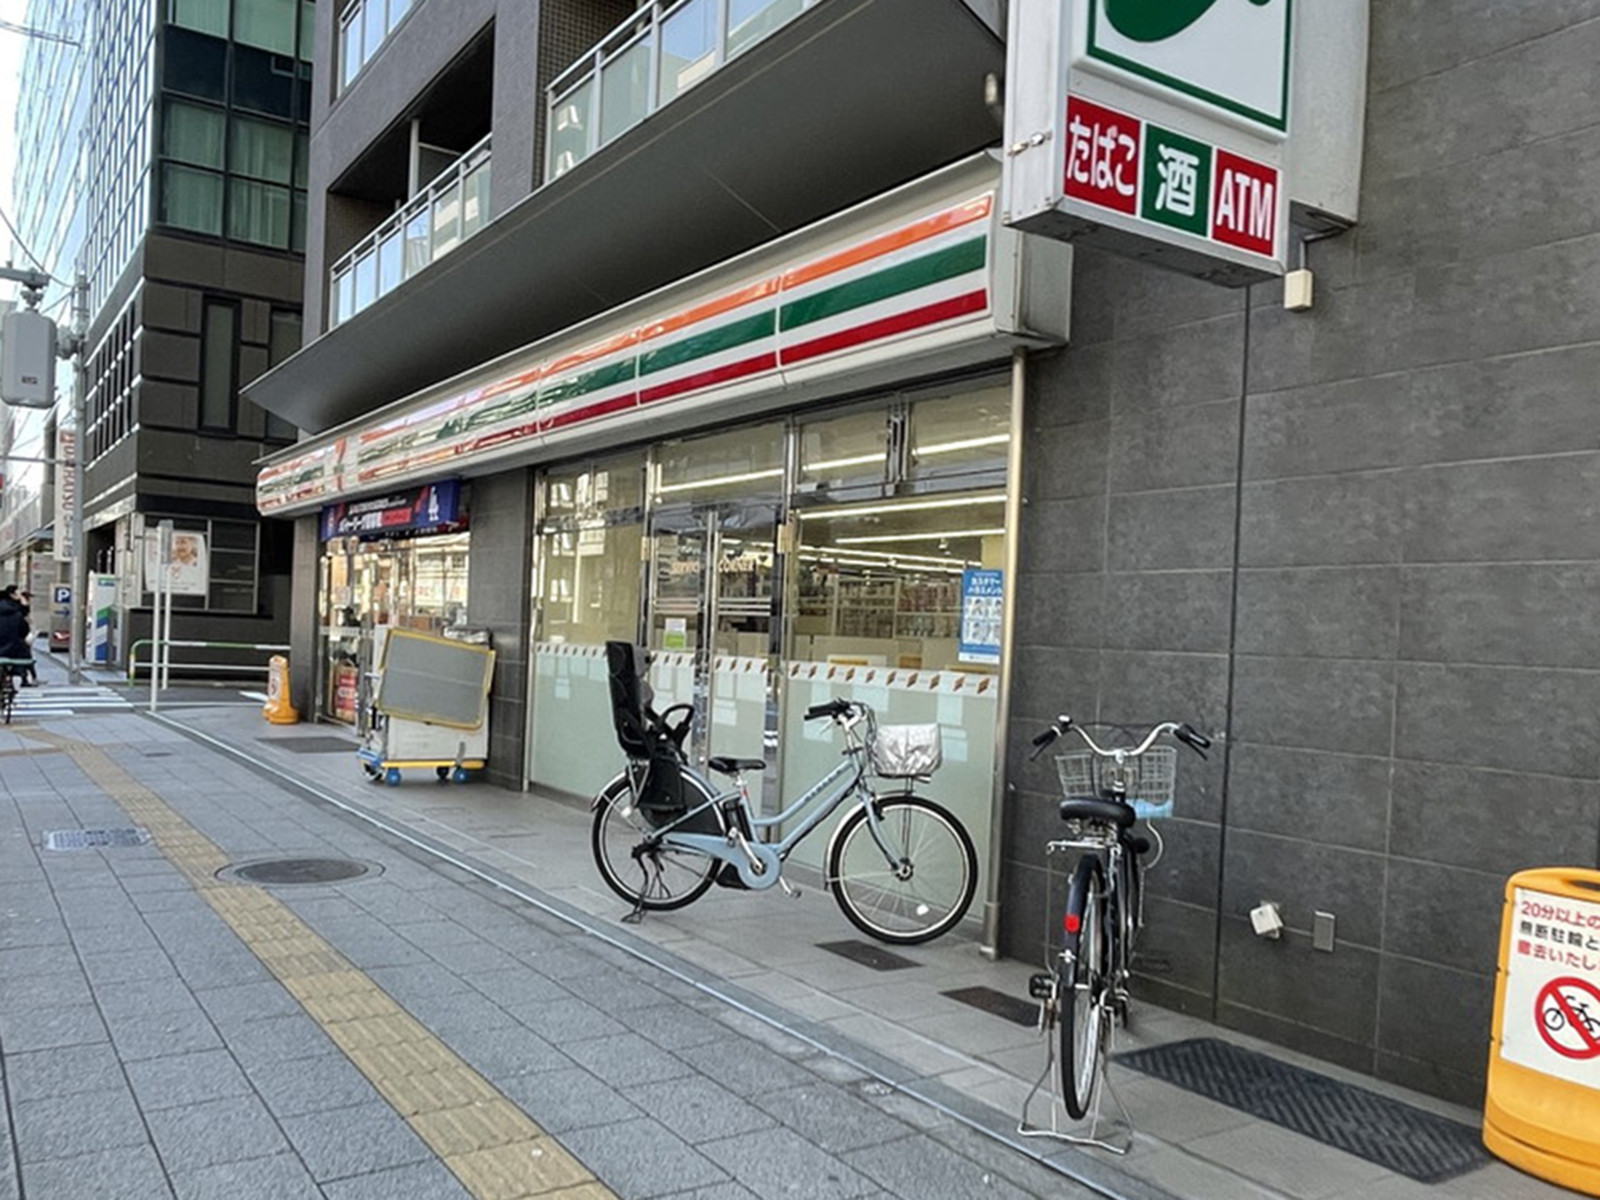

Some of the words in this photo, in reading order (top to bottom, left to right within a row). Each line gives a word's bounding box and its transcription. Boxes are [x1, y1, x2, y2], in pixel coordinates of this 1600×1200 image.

[1067, 114, 1135, 196] たばこ
[1154, 143, 1200, 217] 酒
[1216, 168, 1274, 242] ATM
[1521, 900, 1600, 930] 20分以上の
[1517, 939, 1600, 971] 去いたし
